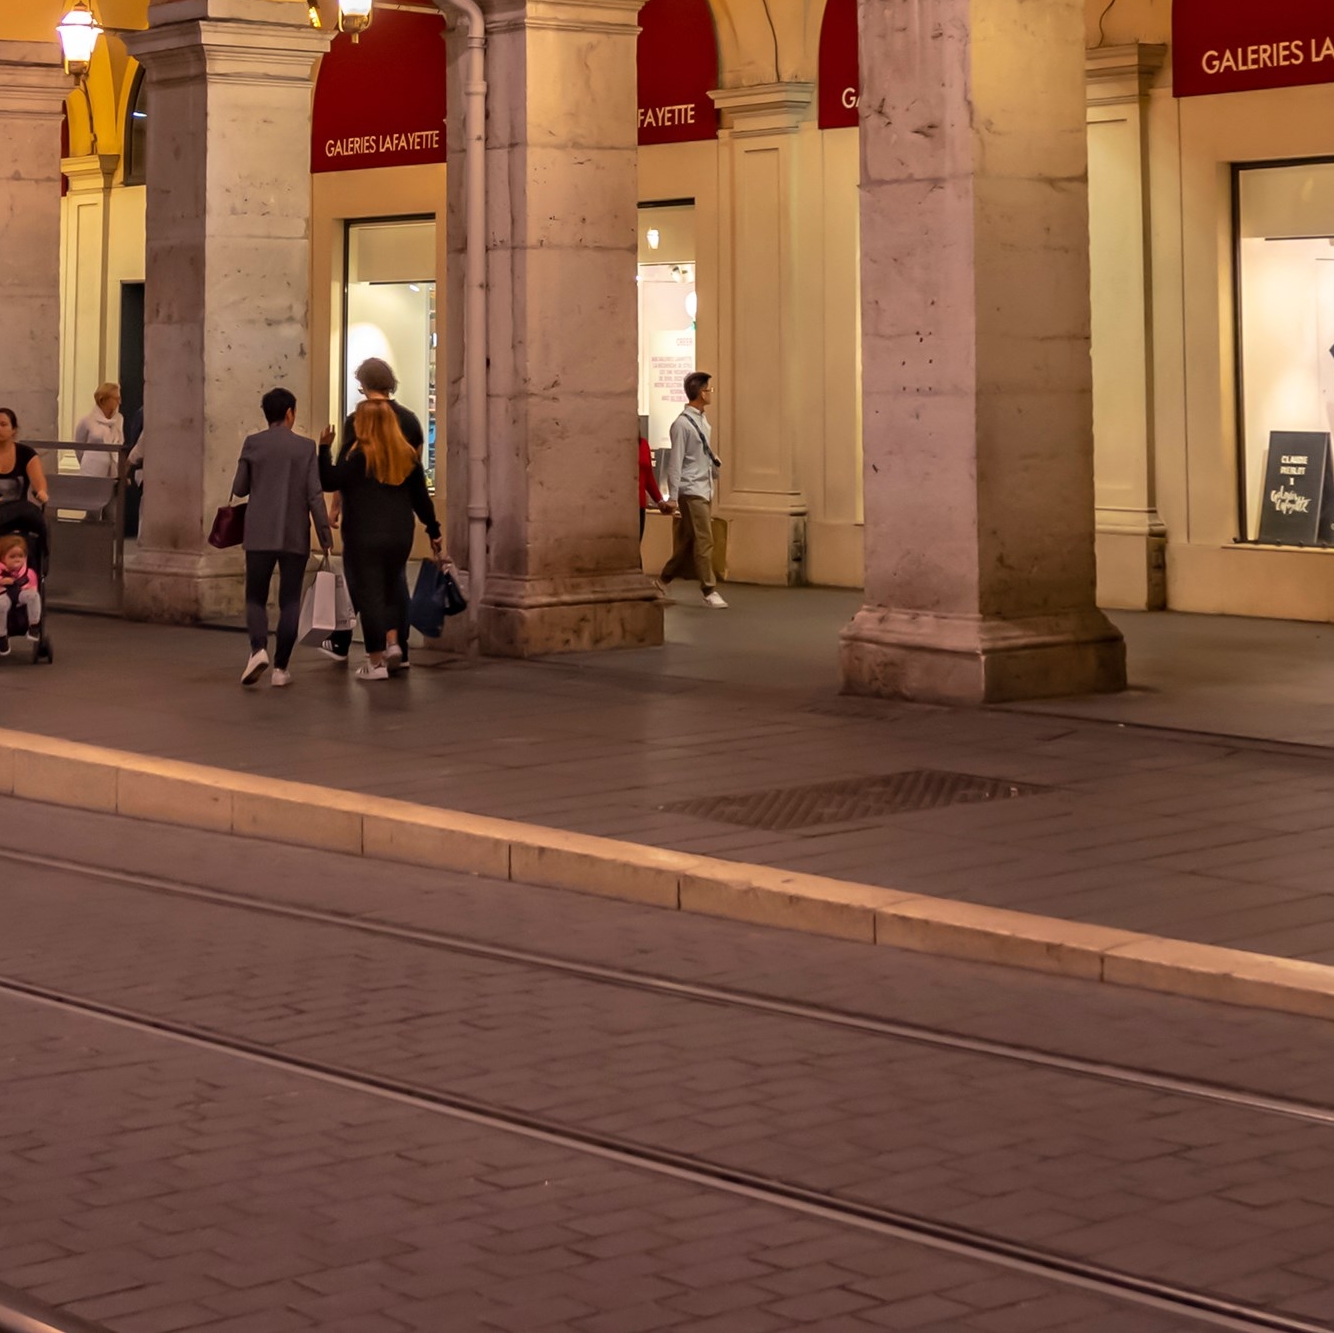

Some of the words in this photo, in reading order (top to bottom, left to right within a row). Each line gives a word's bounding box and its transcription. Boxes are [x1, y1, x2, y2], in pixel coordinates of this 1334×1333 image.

[1202, 40, 1304, 75] GALERIES
[638, 103, 696, 128] FAYETTE
[325, 135, 376, 157] GALERIES
[378, 130, 440, 153] LAFAYETTE
